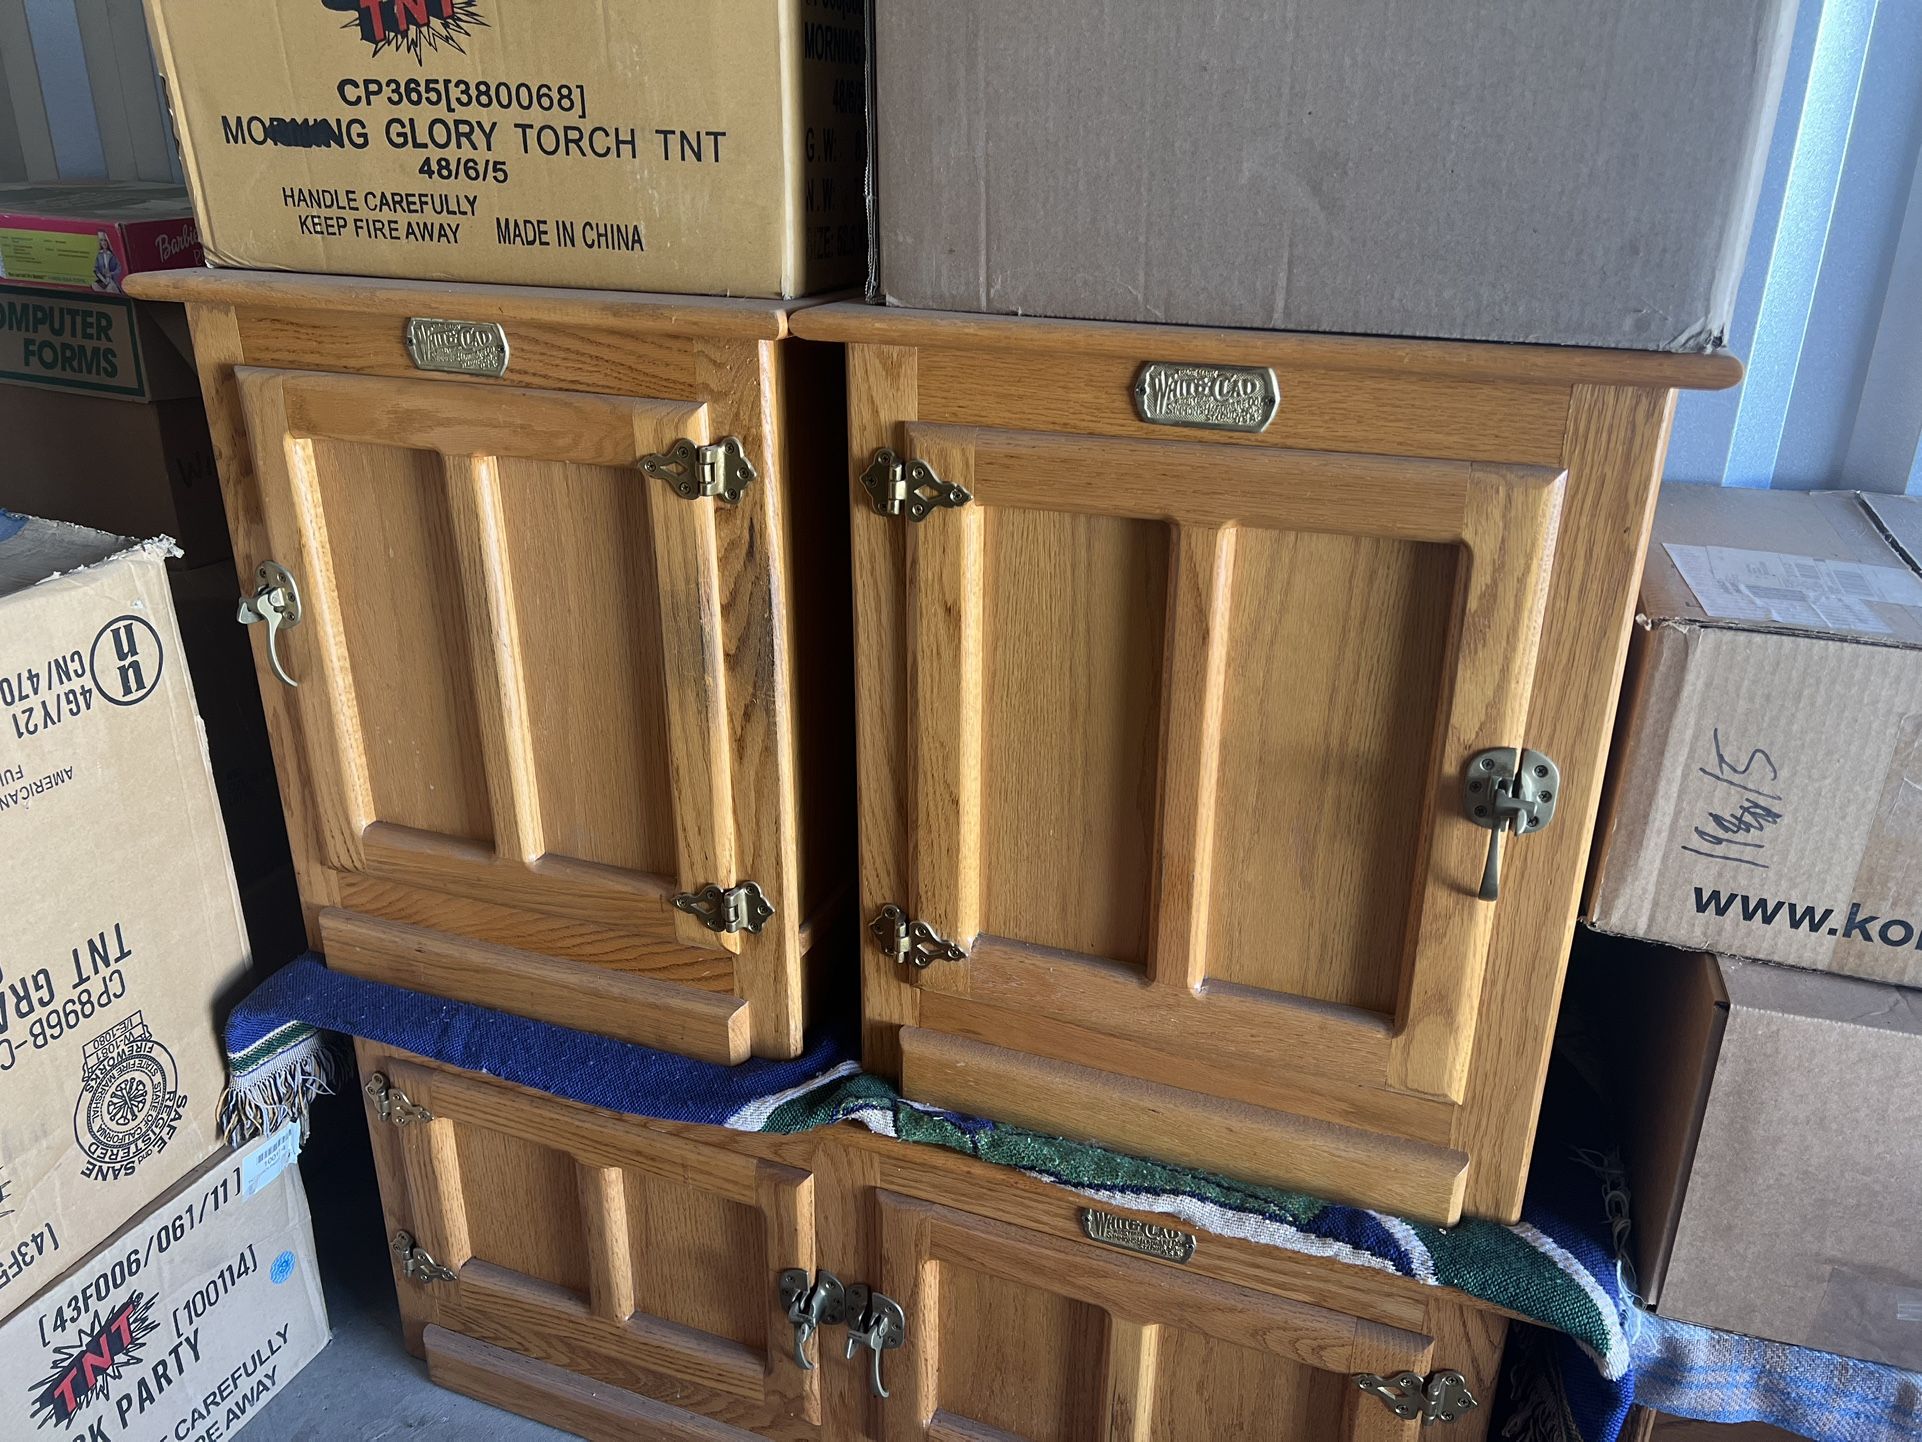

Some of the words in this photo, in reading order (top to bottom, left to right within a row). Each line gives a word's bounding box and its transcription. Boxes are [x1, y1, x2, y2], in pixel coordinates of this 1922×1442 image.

[337, 78, 587, 119] CP365[380068]
[385, 117, 498, 151] GLORY
[514, 123, 637, 159] TORCH
[655, 129, 727, 163] TNT
[419, 157, 509, 184] 48/6/5
[282, 187, 359, 211] HANDLE
[364, 191, 478, 216] CAREFULLY
[155, 224, 199, 262] Barbie
[298, 215, 348, 236] KEEP
[353, 218, 401, 240] FIRE
[405, 221, 461, 244] AWAY
[496, 217, 550, 246] MADE
[555, 220, 576, 247] IN
[581, 221, 644, 251] CHINA
[23, 338, 119, 378] FORMS
[72, 922, 132, 990] TNT
[95, 1031, 134, 1063] W-1081
[85, 1042, 154, 1094] FIREWORKS
[117, 1059, 137, 1077] FIRE
[138, 1059, 158, 1077] STATE
[91, 1073, 116, 1123] MARSHAL
[153, 1083, 163, 1113] STATE
[87, 1091, 176, 1162] REGISTERED
[97, 1124, 143, 1144] CALIFORNIA
[142, 1115, 154, 1131] OF
[157, 1094, 188, 1154] SAFE
[80, 1160, 136, 1182] SANE
[137, 1149, 153, 1165] and
[172, 1244, 258, 1339] [100114]
[54, 1303, 135, 1414] TNT
[116, 1328, 200, 1430] PARTY
[174, 1323, 289, 1440] CAREFULLY
[225, 1365, 277, 1431] AWAY
